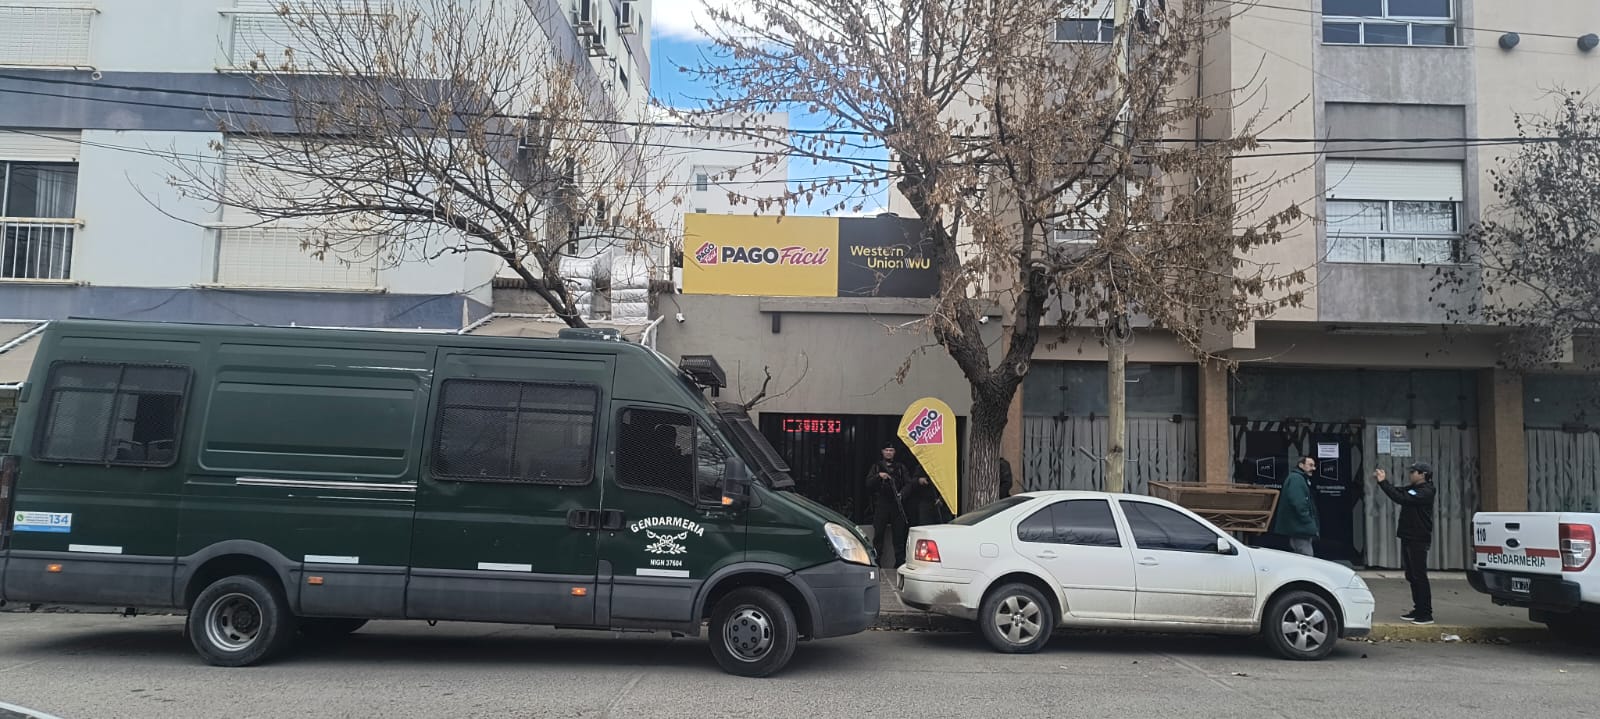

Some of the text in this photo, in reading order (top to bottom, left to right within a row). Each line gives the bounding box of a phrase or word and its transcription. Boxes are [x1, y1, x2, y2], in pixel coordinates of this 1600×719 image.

[721, 246, 779, 264] PAGO
[780, 246, 829, 265] Fácil
[850, 245, 904, 257] Western
[867, 257, 904, 269] Union
[908, 410, 938, 441] PAGO
[49, 514, 68, 525] 134
[630, 516, 704, 537] GENDARMERIA
[1477, 528, 1486, 542] 110
[1487, 553, 1546, 568] GENDARMERIA
